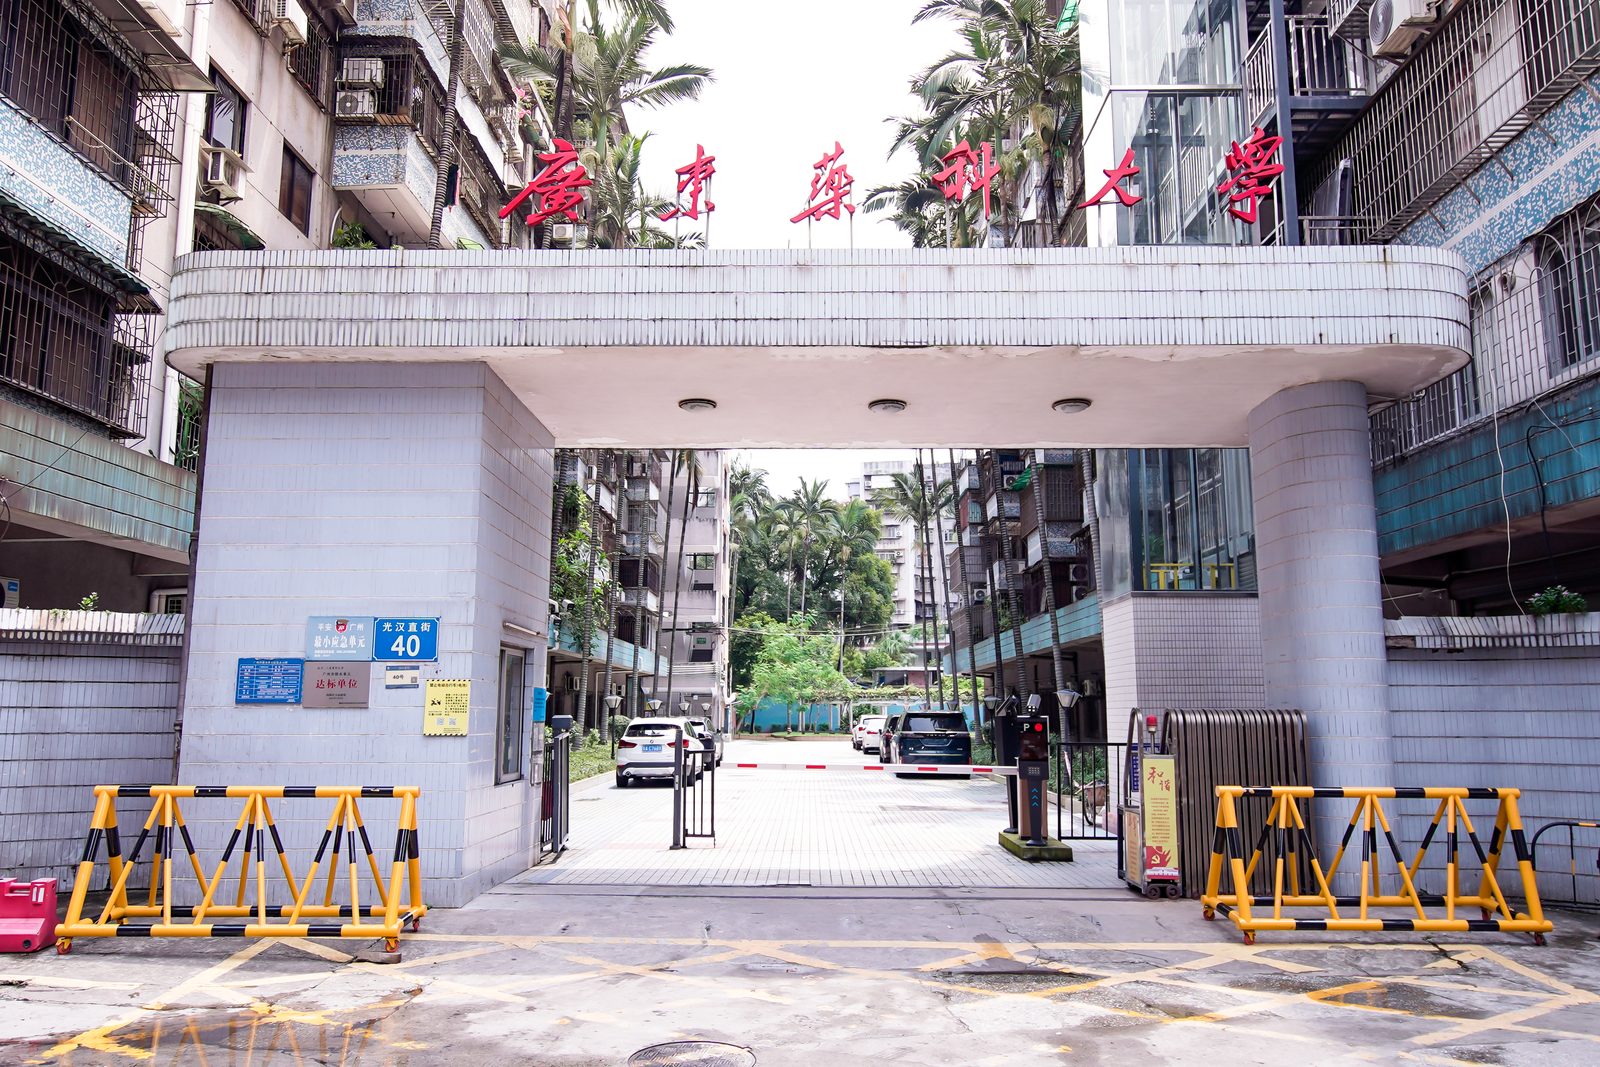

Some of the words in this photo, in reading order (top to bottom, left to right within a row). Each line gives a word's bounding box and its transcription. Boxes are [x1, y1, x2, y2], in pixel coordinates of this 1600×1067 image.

[318, 623, 332, 632] 平安
[349, 623, 364, 632] 广州
[382, 622, 431, 633] 光汉直街
[314, 635, 366, 649] 最小应急单元
[390, 634, 421, 657] 40
[315, 678, 359, 689] 达标单位
[1023, 723, 1030, 732] P
[1147, 766, 1171, 792] 和谐
